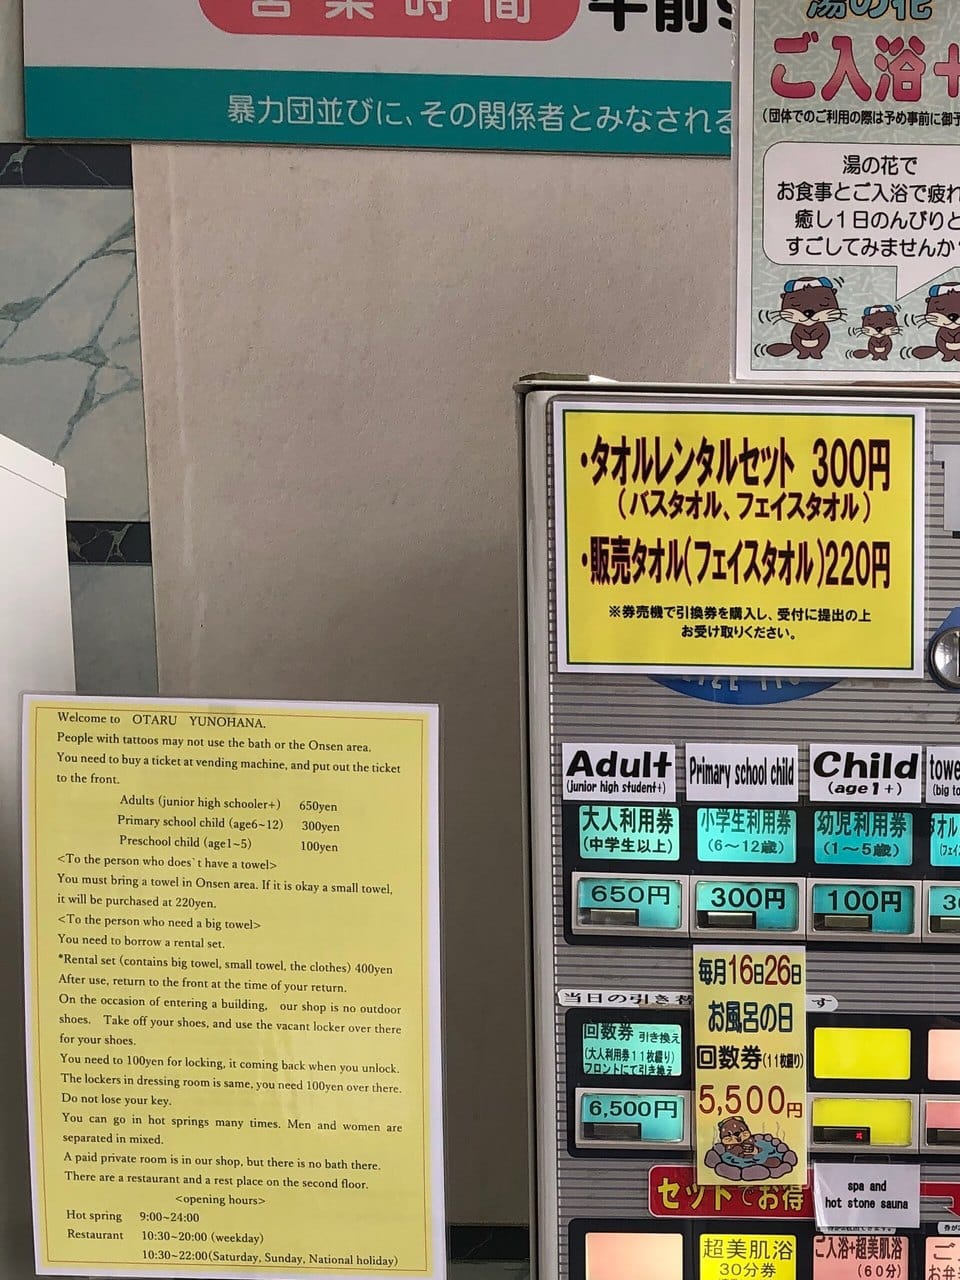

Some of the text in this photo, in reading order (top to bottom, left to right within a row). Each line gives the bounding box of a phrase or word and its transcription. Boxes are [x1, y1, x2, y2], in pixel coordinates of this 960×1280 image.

[842, 154, 918, 177] 湯の花で
[811, 437, 892, 492] 300円
[680, 624, 798, 641] お受け取りください。
[57, 711, 266, 729] Welcome to OTARU YUNOHANA.
[565, 750, 673, 779] Adult
[689, 756, 795, 789] Primary school child
[813, 750, 919, 780] Child
[566, 780, 597, 794] (junior
[600, 780, 620, 794] high
[932, 785, 950, 799] (big
[119, 794, 338, 814] Adults (junior high schooler+) 650yen
[117, 814, 161, 829] Primary
[162, 816, 197, 829] school
[199, 816, 226, 830] child
[301, 820, 340, 834] 300yen
[582, 806, 674, 835] 大人利用券
[701, 809, 792, 836] 小学生利用券
[816, 811, 908, 839] 幼児利用券
[590, 885, 671, 906] 650円
[710, 887, 787, 910] 300円
[827, 889, 903, 914] 100円
[698, 954, 802, 986] 毎月16日26日
[707, 1000, 794, 1034] お風呂の日
[583, 1023, 682, 1045] 回数券 引き換え
[61, 1092, 172, 1109] Do not lose your key.
[588, 1100, 679, 1119] 6,500円
[698, 1084, 804, 1119] 5,500円
[847, 1180, 887, 1193] spa and
[825, 1196, 909, 1210] hot stone sauna
[66, 1209, 87, 1221] Hot
[89, 1210, 123, 1224] spring
[264, 1252, 400, 1269] Sunday, National holiday)
[703, 1238, 794, 1261] 超美肌浴
[719, 1263, 777, 1278] 30分券
